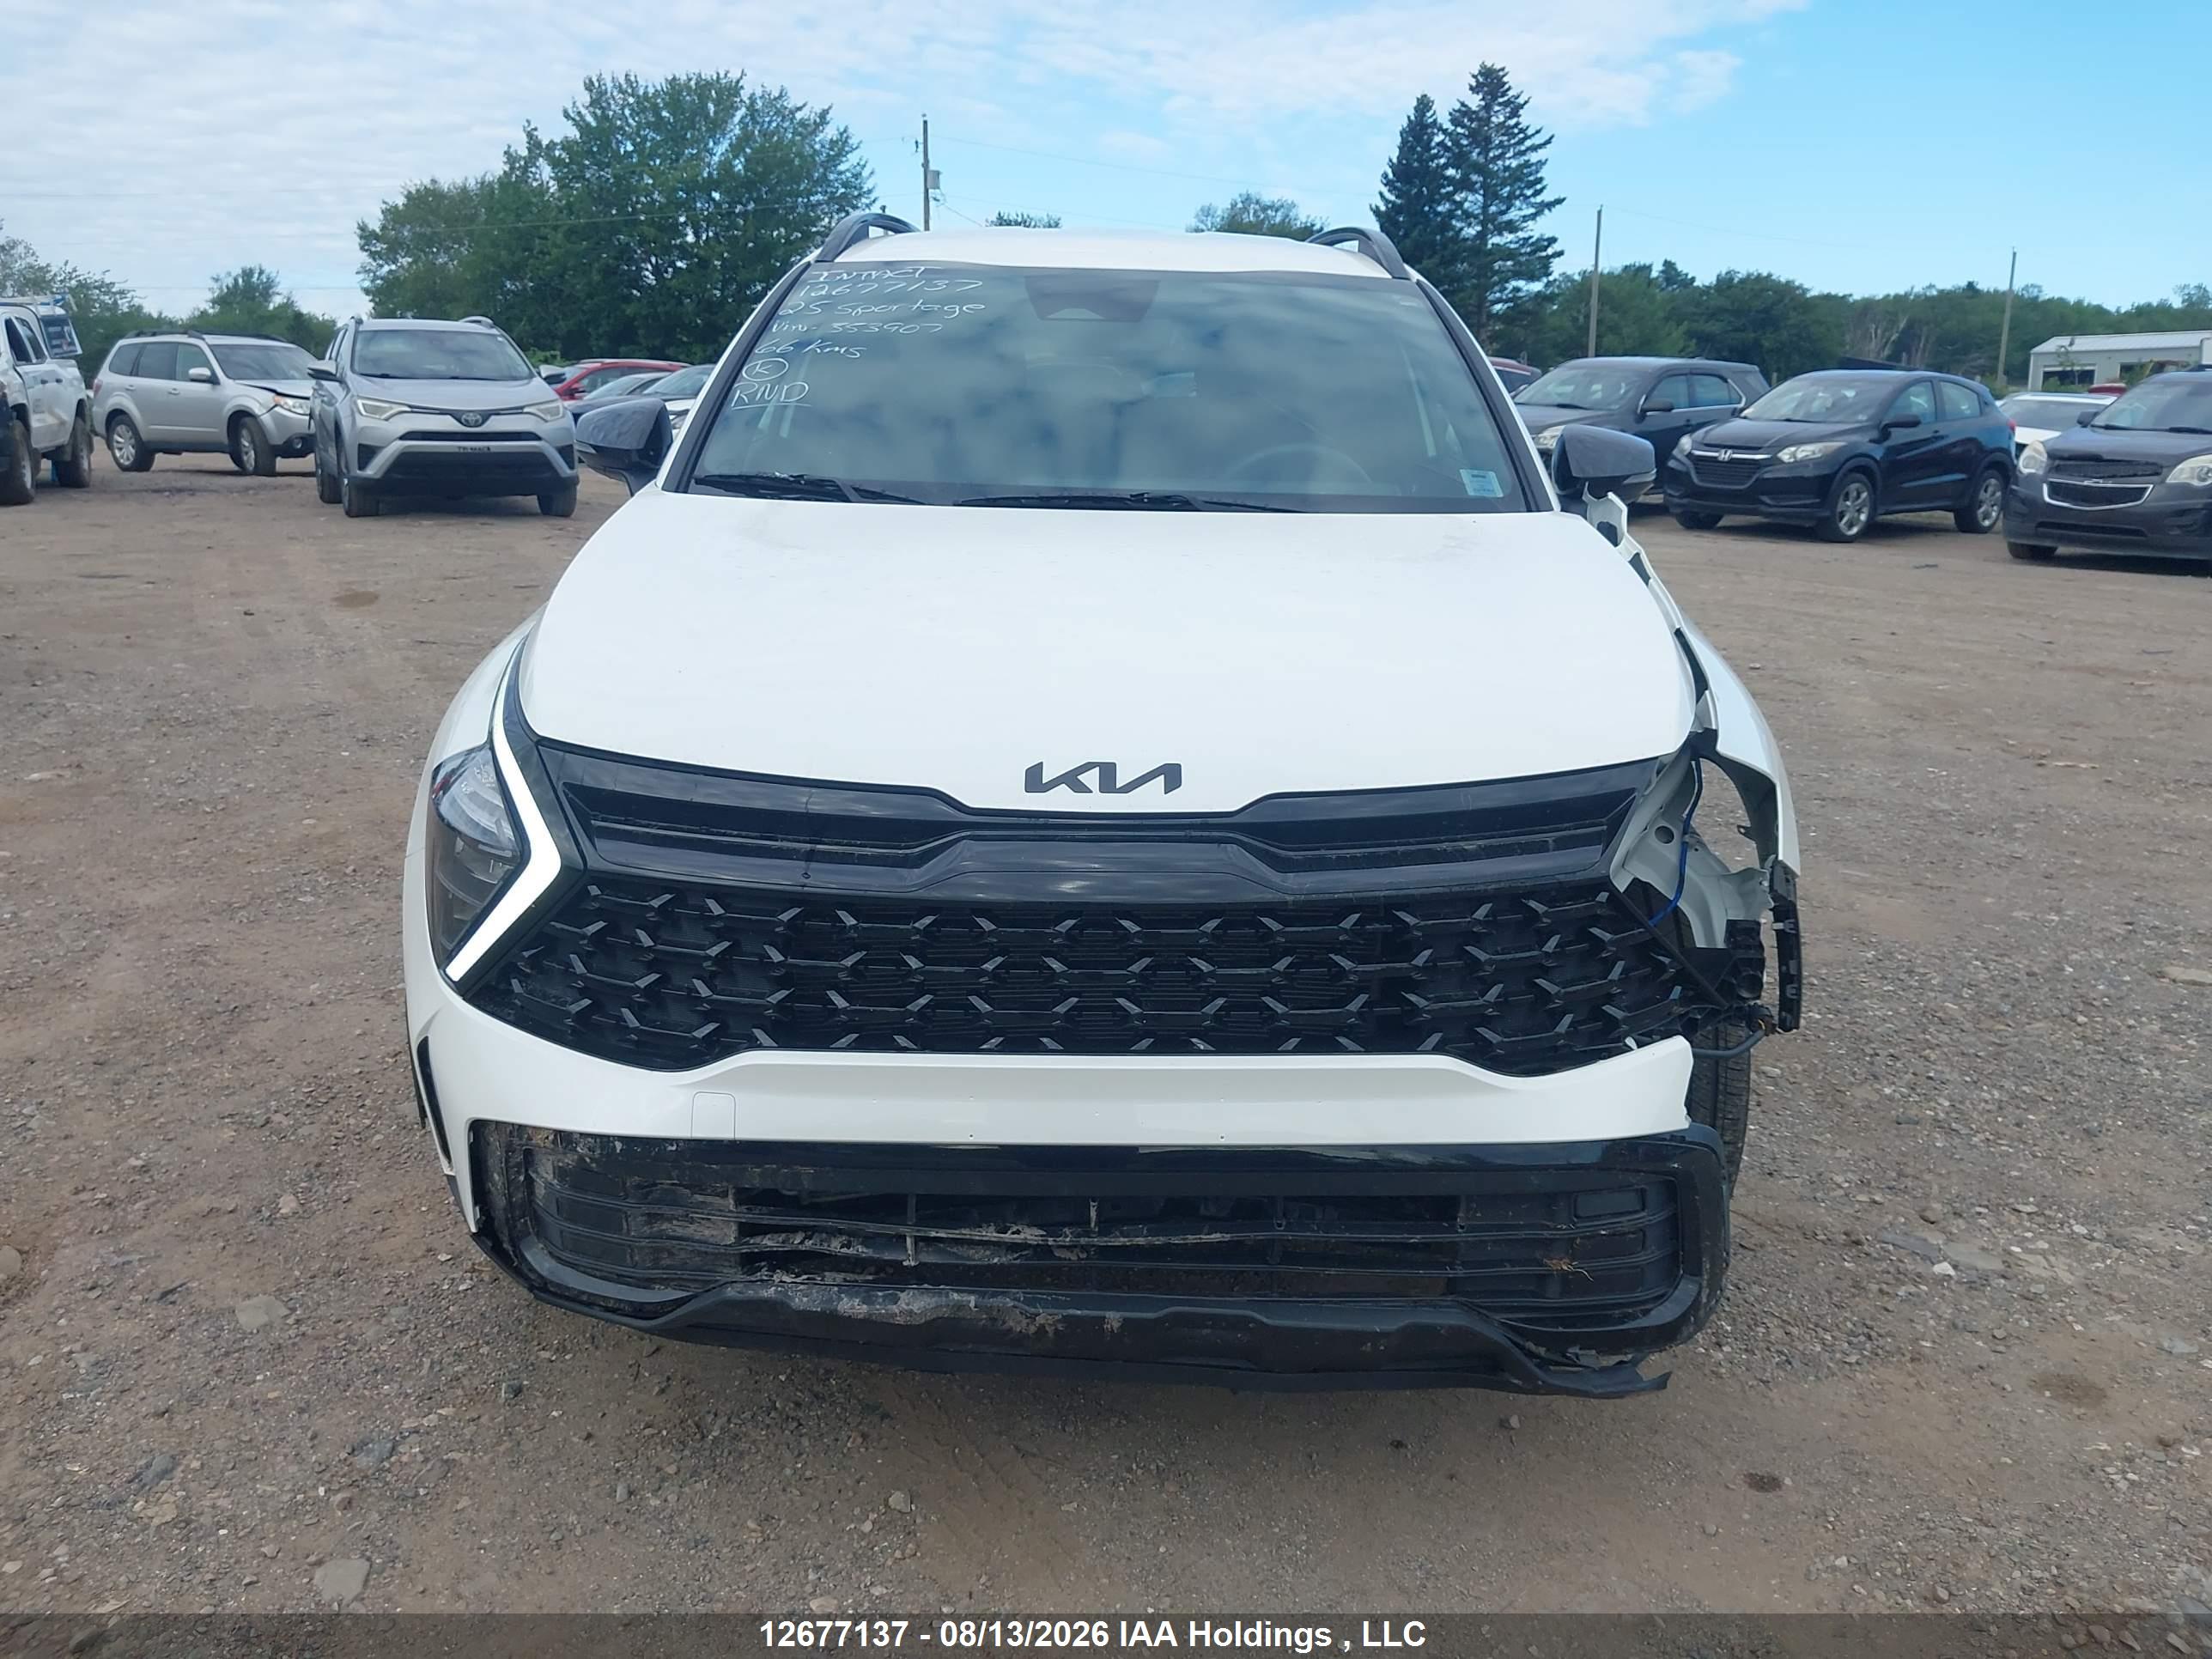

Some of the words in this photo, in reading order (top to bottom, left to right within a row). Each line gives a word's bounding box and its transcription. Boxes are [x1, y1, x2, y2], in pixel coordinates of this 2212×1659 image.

[799, 280, 983, 297] 12677137
[778, 300, 833, 316] 25
[731, 382, 810, 407] RND
